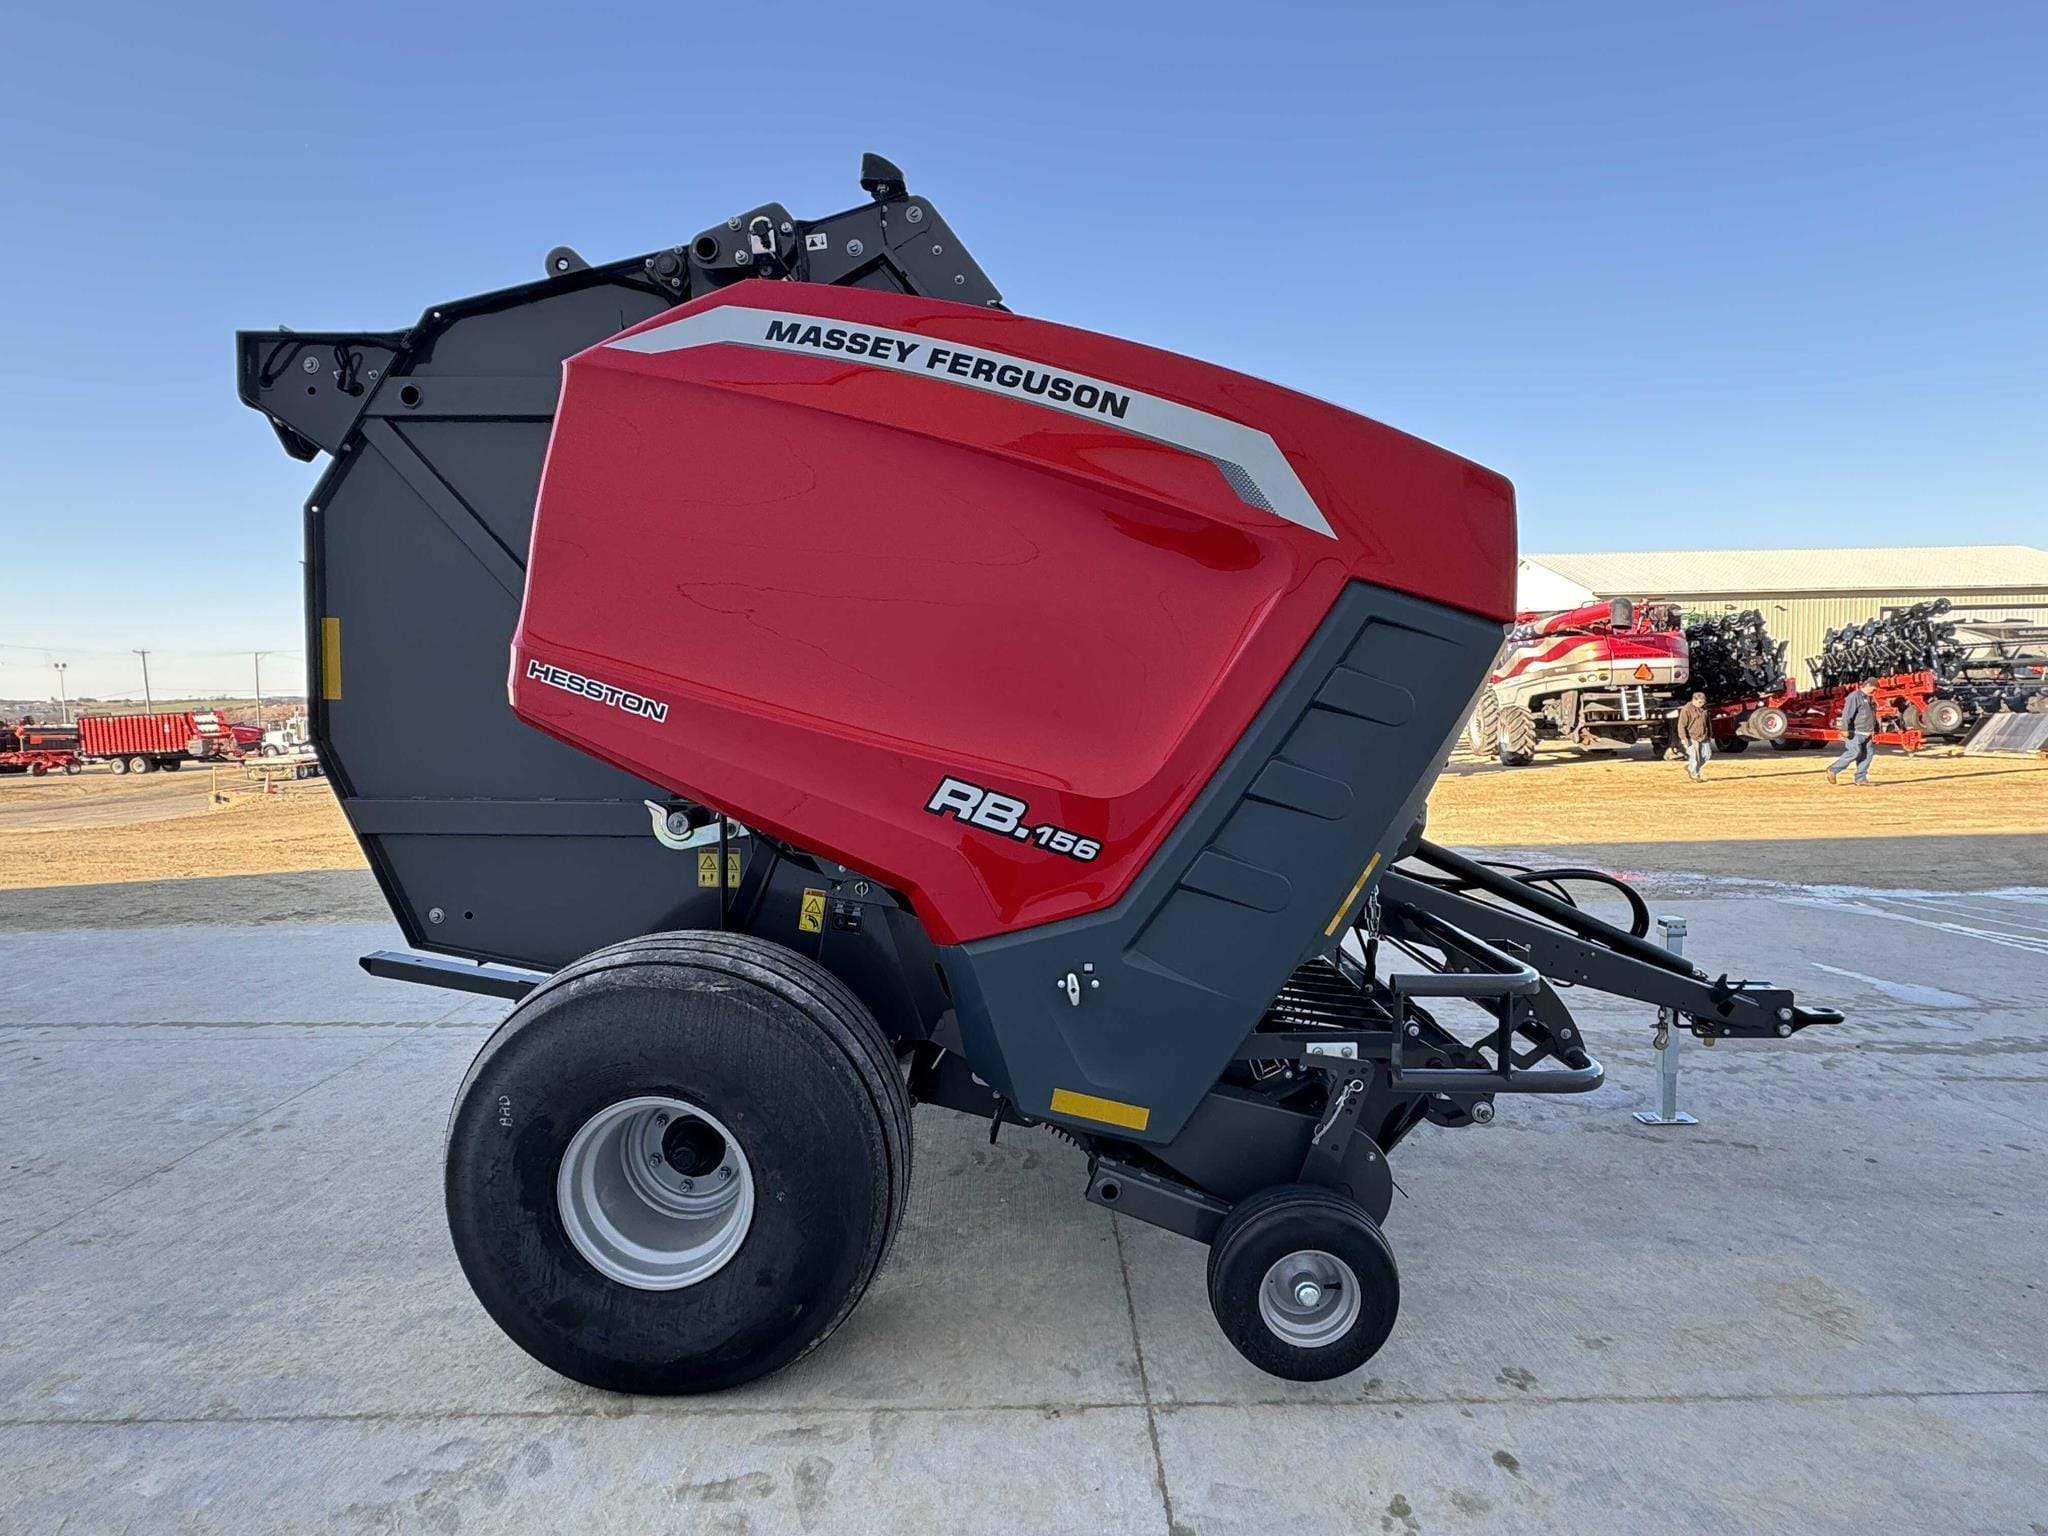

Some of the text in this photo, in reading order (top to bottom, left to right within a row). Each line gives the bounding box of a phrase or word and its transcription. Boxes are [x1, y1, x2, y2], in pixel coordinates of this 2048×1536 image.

[765, 320, 1131, 419] MASSEY FERGUSON
[527, 659, 669, 722] HESSTON
